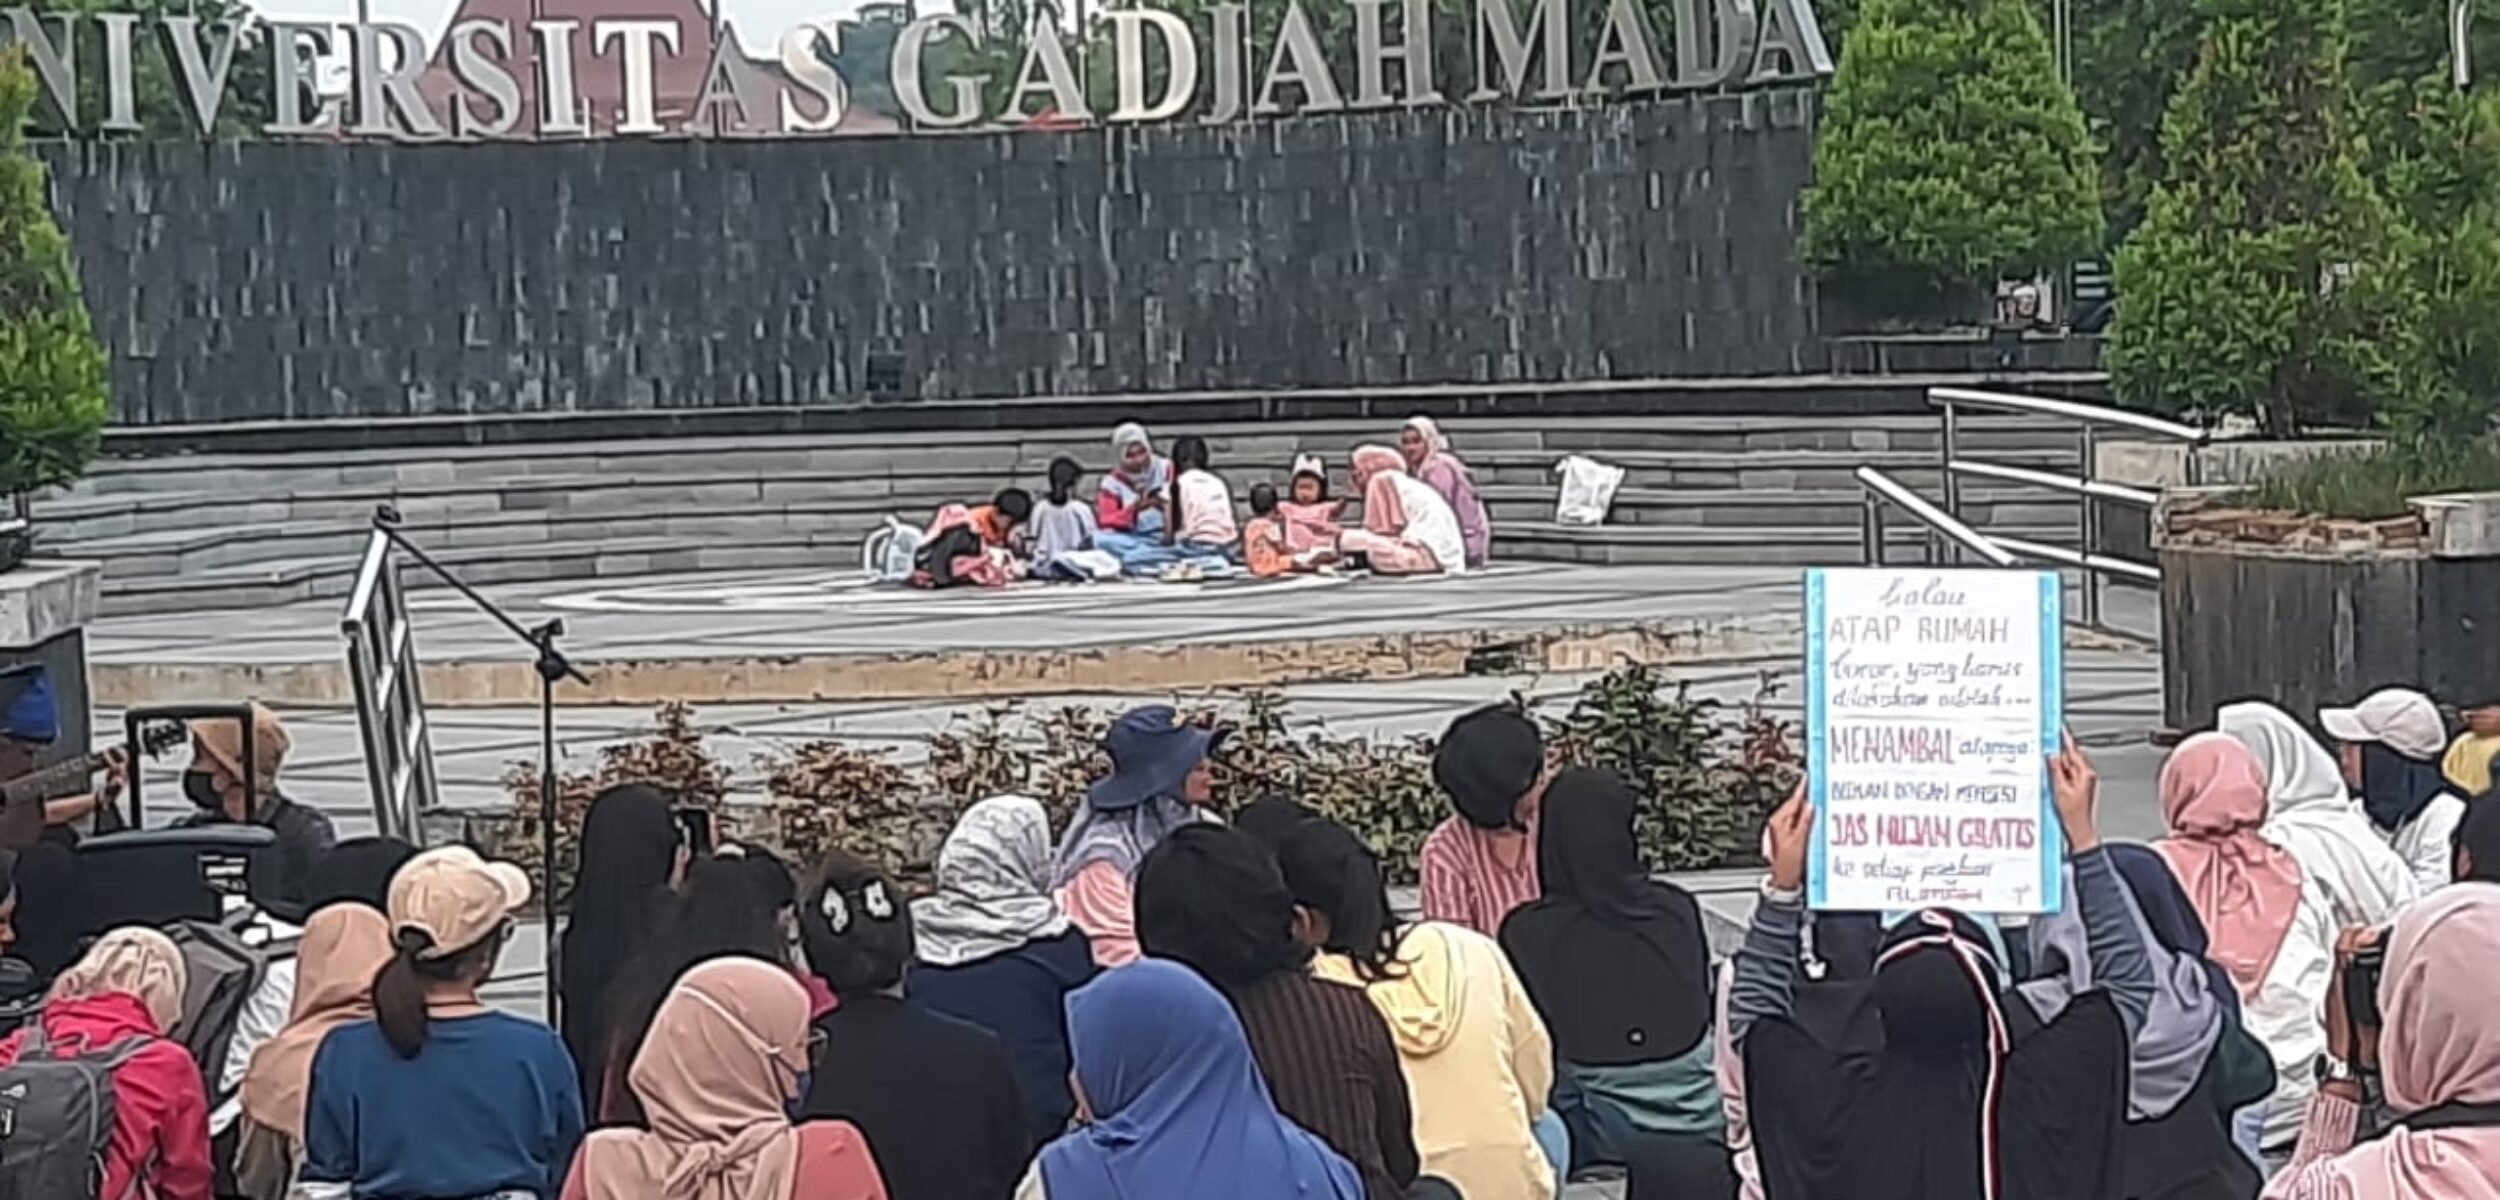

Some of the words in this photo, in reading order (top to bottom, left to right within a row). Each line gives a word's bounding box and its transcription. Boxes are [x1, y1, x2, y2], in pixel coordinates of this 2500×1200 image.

[891, 0, 1443, 127] GADJAH
[1466, 0, 1834, 99] MADA
[1829, 615, 1900, 643] ATAP
[1918, 617, 2010, 644] RUMAH
[1831, 725, 1956, 765] MENAMBAL
[1830, 813, 1869, 847] JAS
[1876, 813, 1952, 848] HUJAN
[1957, 817, 2036, 849] GRATIS
